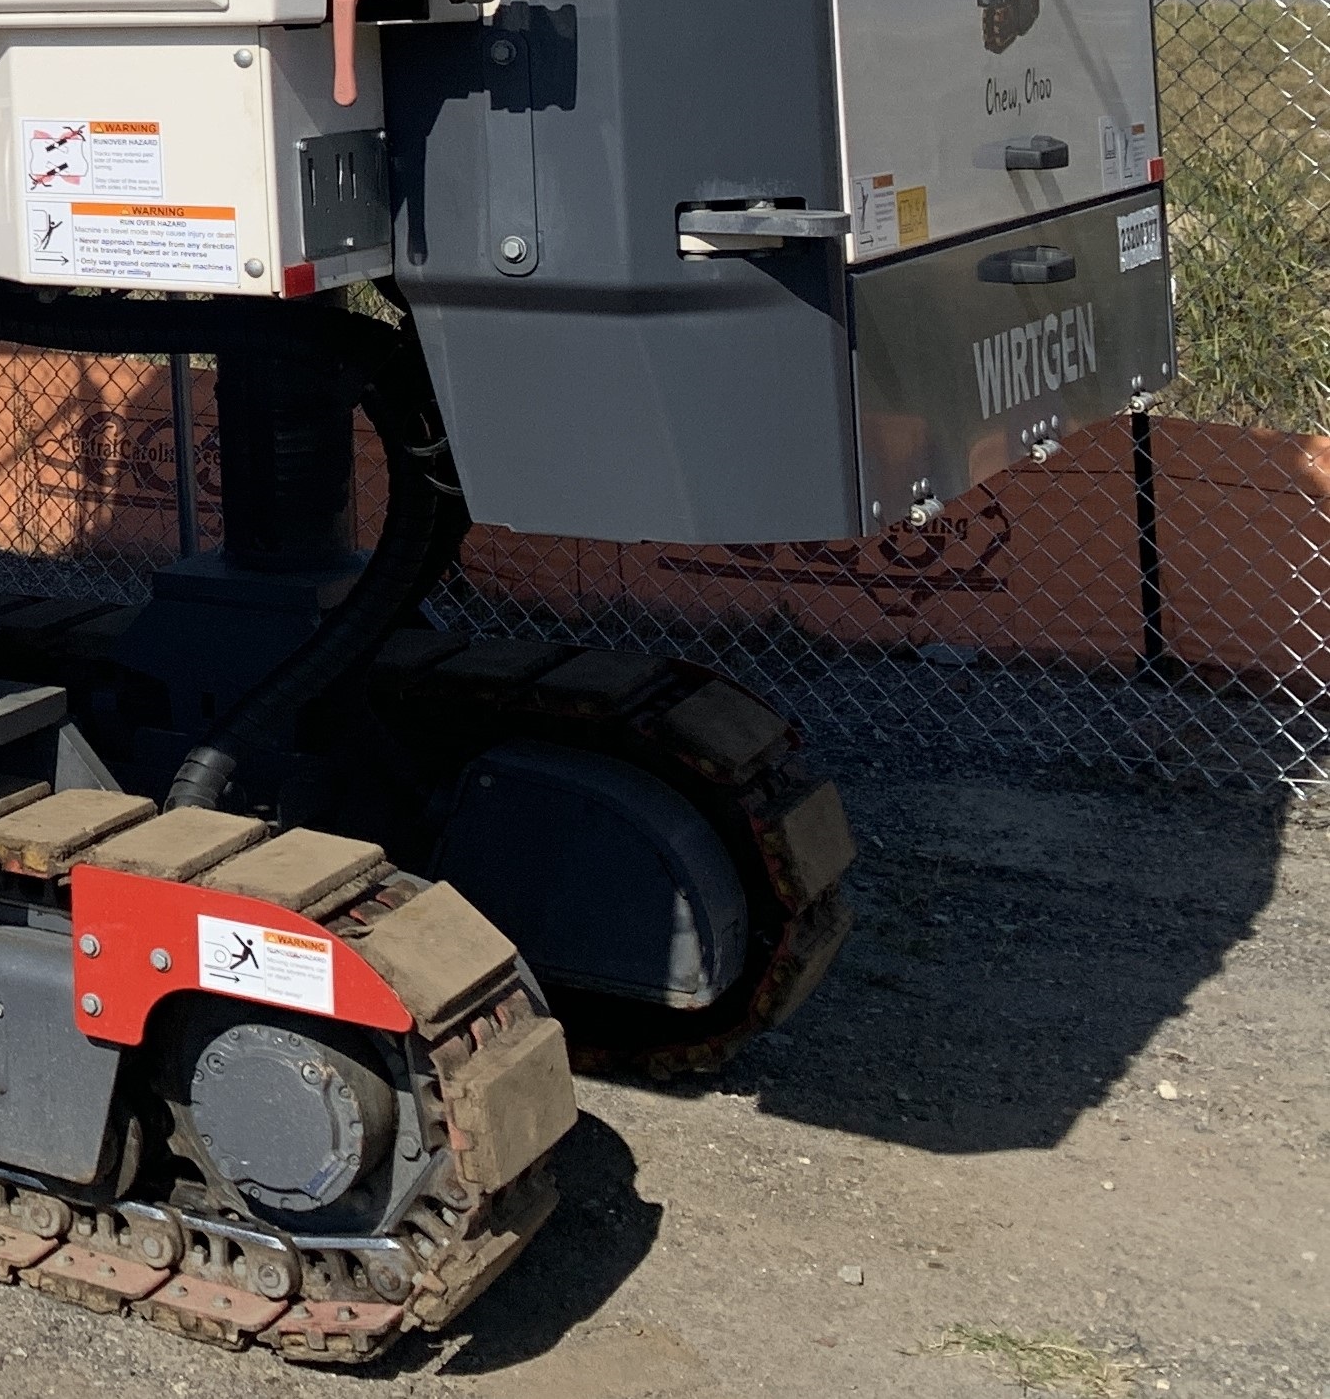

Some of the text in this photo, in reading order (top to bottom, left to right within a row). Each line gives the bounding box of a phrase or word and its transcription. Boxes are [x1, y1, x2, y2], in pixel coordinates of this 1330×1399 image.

[985, 68, 1052, 116] Chew, Choo
[104, 123, 157, 133] WARNING
[132, 206, 185, 217] WARNING
[202, 242, 235, 250] direction
[81, 257, 97, 266] Only
[973, 302, 1096, 420] WIRTGEN
[277, 935, 326, 952] WARNING
